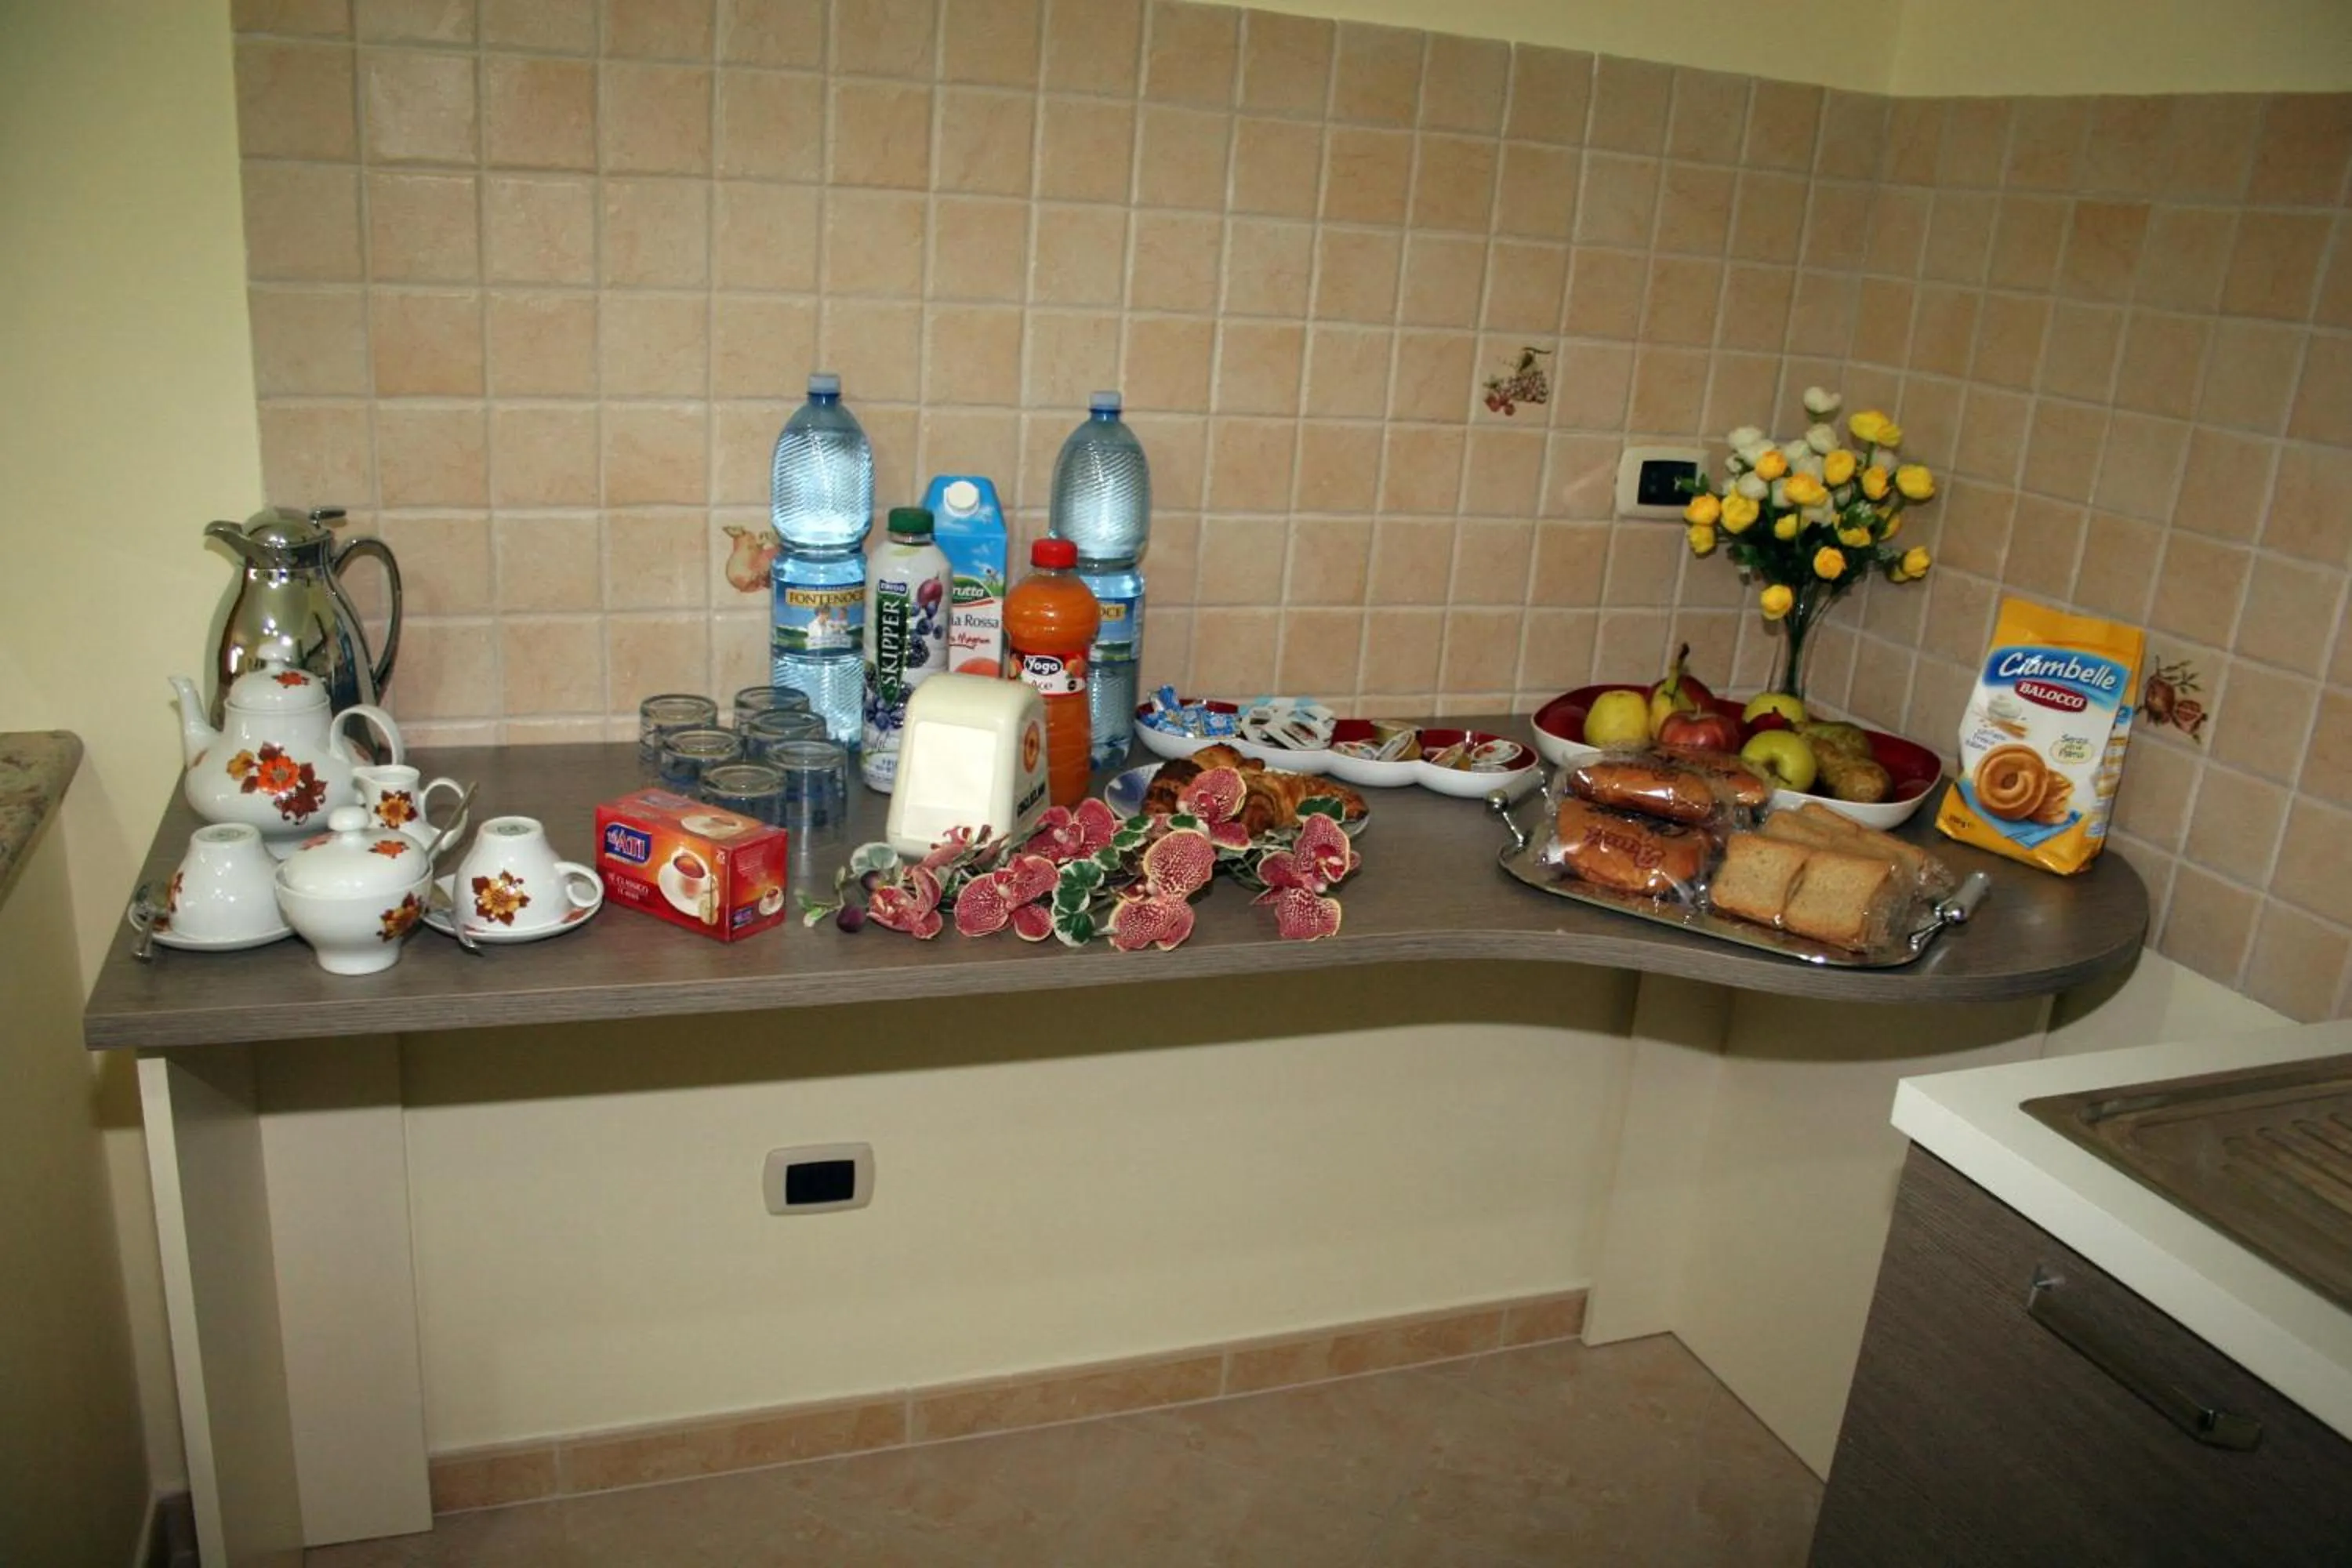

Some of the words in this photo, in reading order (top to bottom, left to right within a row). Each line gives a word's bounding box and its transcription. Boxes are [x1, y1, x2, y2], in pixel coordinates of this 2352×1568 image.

[953, 586, 985, 597] rutta
[964, 614, 1000, 628] Rossa
[880, 599, 901, 688] SKIPPER
[1027, 658, 1059, 675] Yoga
[1998, 652, 2116, 690] Ciambelle
[2019, 681, 2085, 708] BALOCCO
